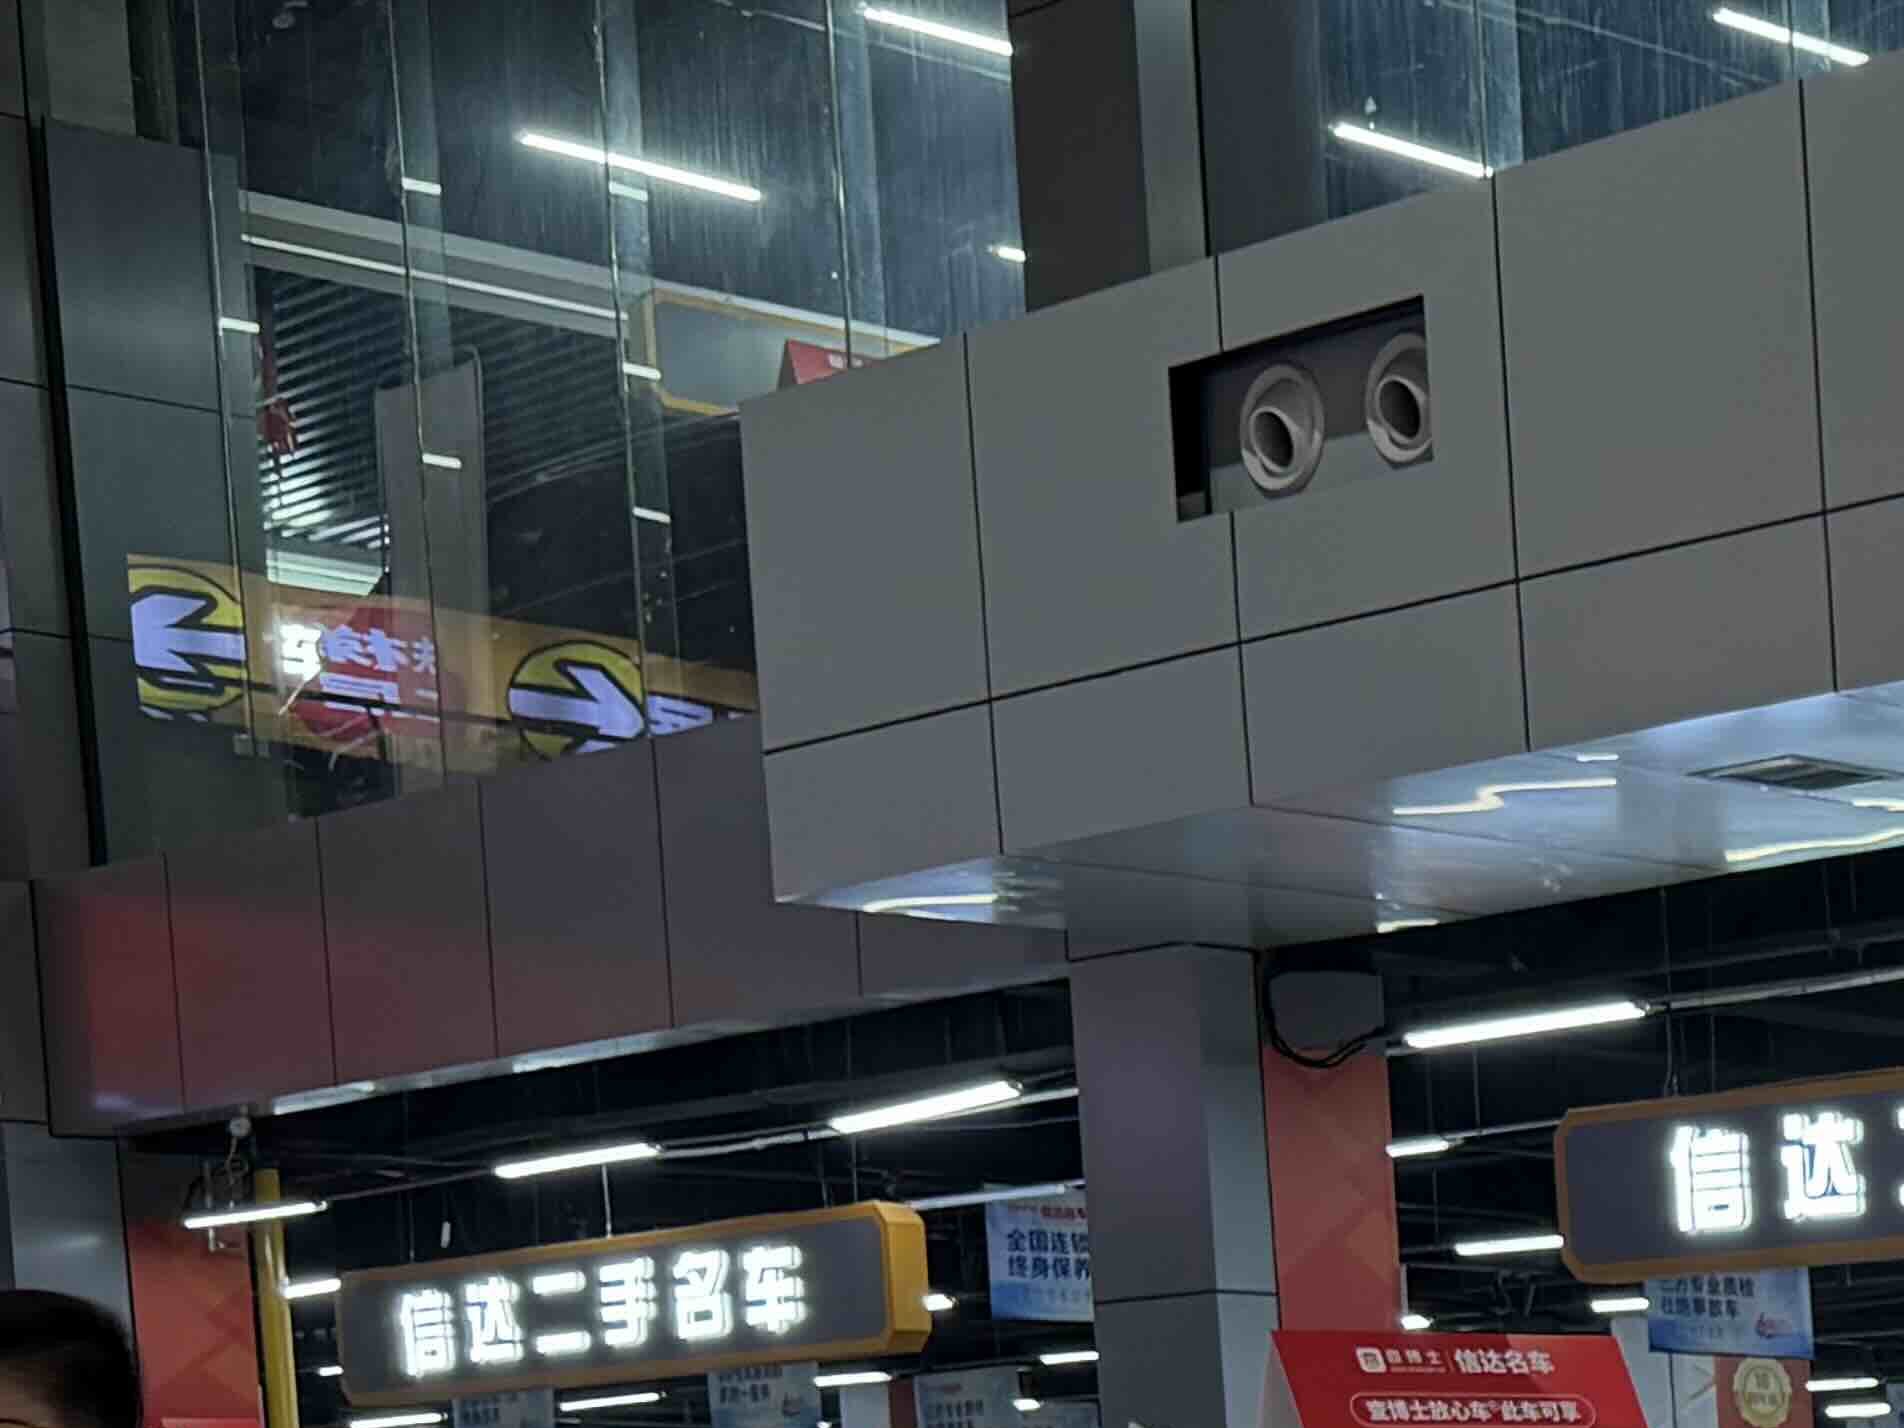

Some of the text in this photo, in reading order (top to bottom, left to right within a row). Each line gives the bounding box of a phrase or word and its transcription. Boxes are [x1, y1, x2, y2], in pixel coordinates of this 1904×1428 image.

[399, 1244, 802, 1377] 信达二手名车
[1455, 1349, 1554, 1374] 信达名车
